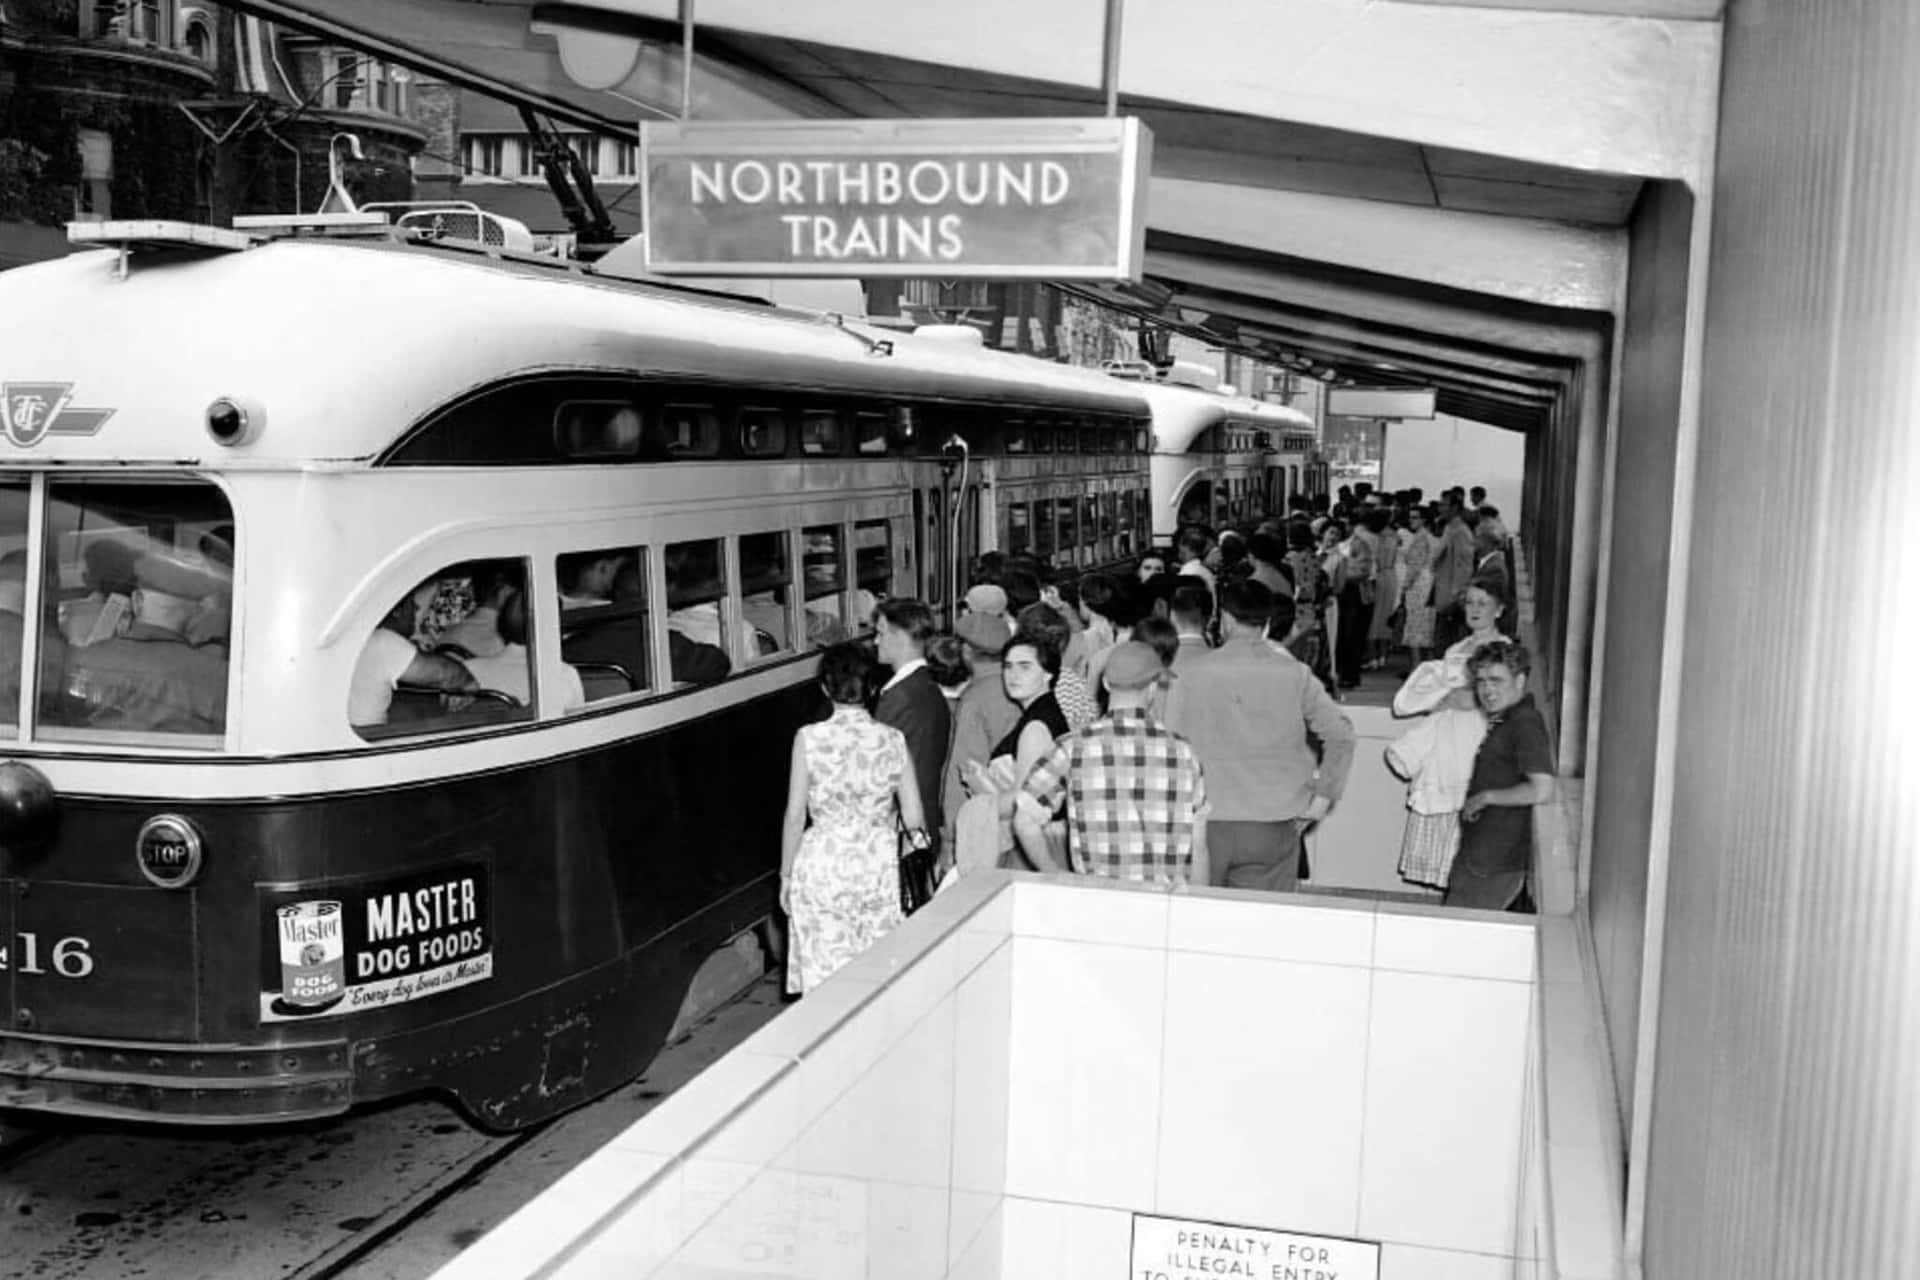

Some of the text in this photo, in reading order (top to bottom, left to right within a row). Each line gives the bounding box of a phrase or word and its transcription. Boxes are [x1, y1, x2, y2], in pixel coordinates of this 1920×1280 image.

[690, 160, 1070, 206] NORTHBOUND
[782, 214, 963, 260] TRAINS
[283, 917, 338, 943] Master
[366, 878, 477, 943] MASTER
[0, 932, 93, 978] 16
[357, 926, 483, 977] DOG FOODS
[1167, 1253, 1339, 1280] ILLEGAL ENTRY
[1177, 1231, 1331, 1264] PENALTY FOR
